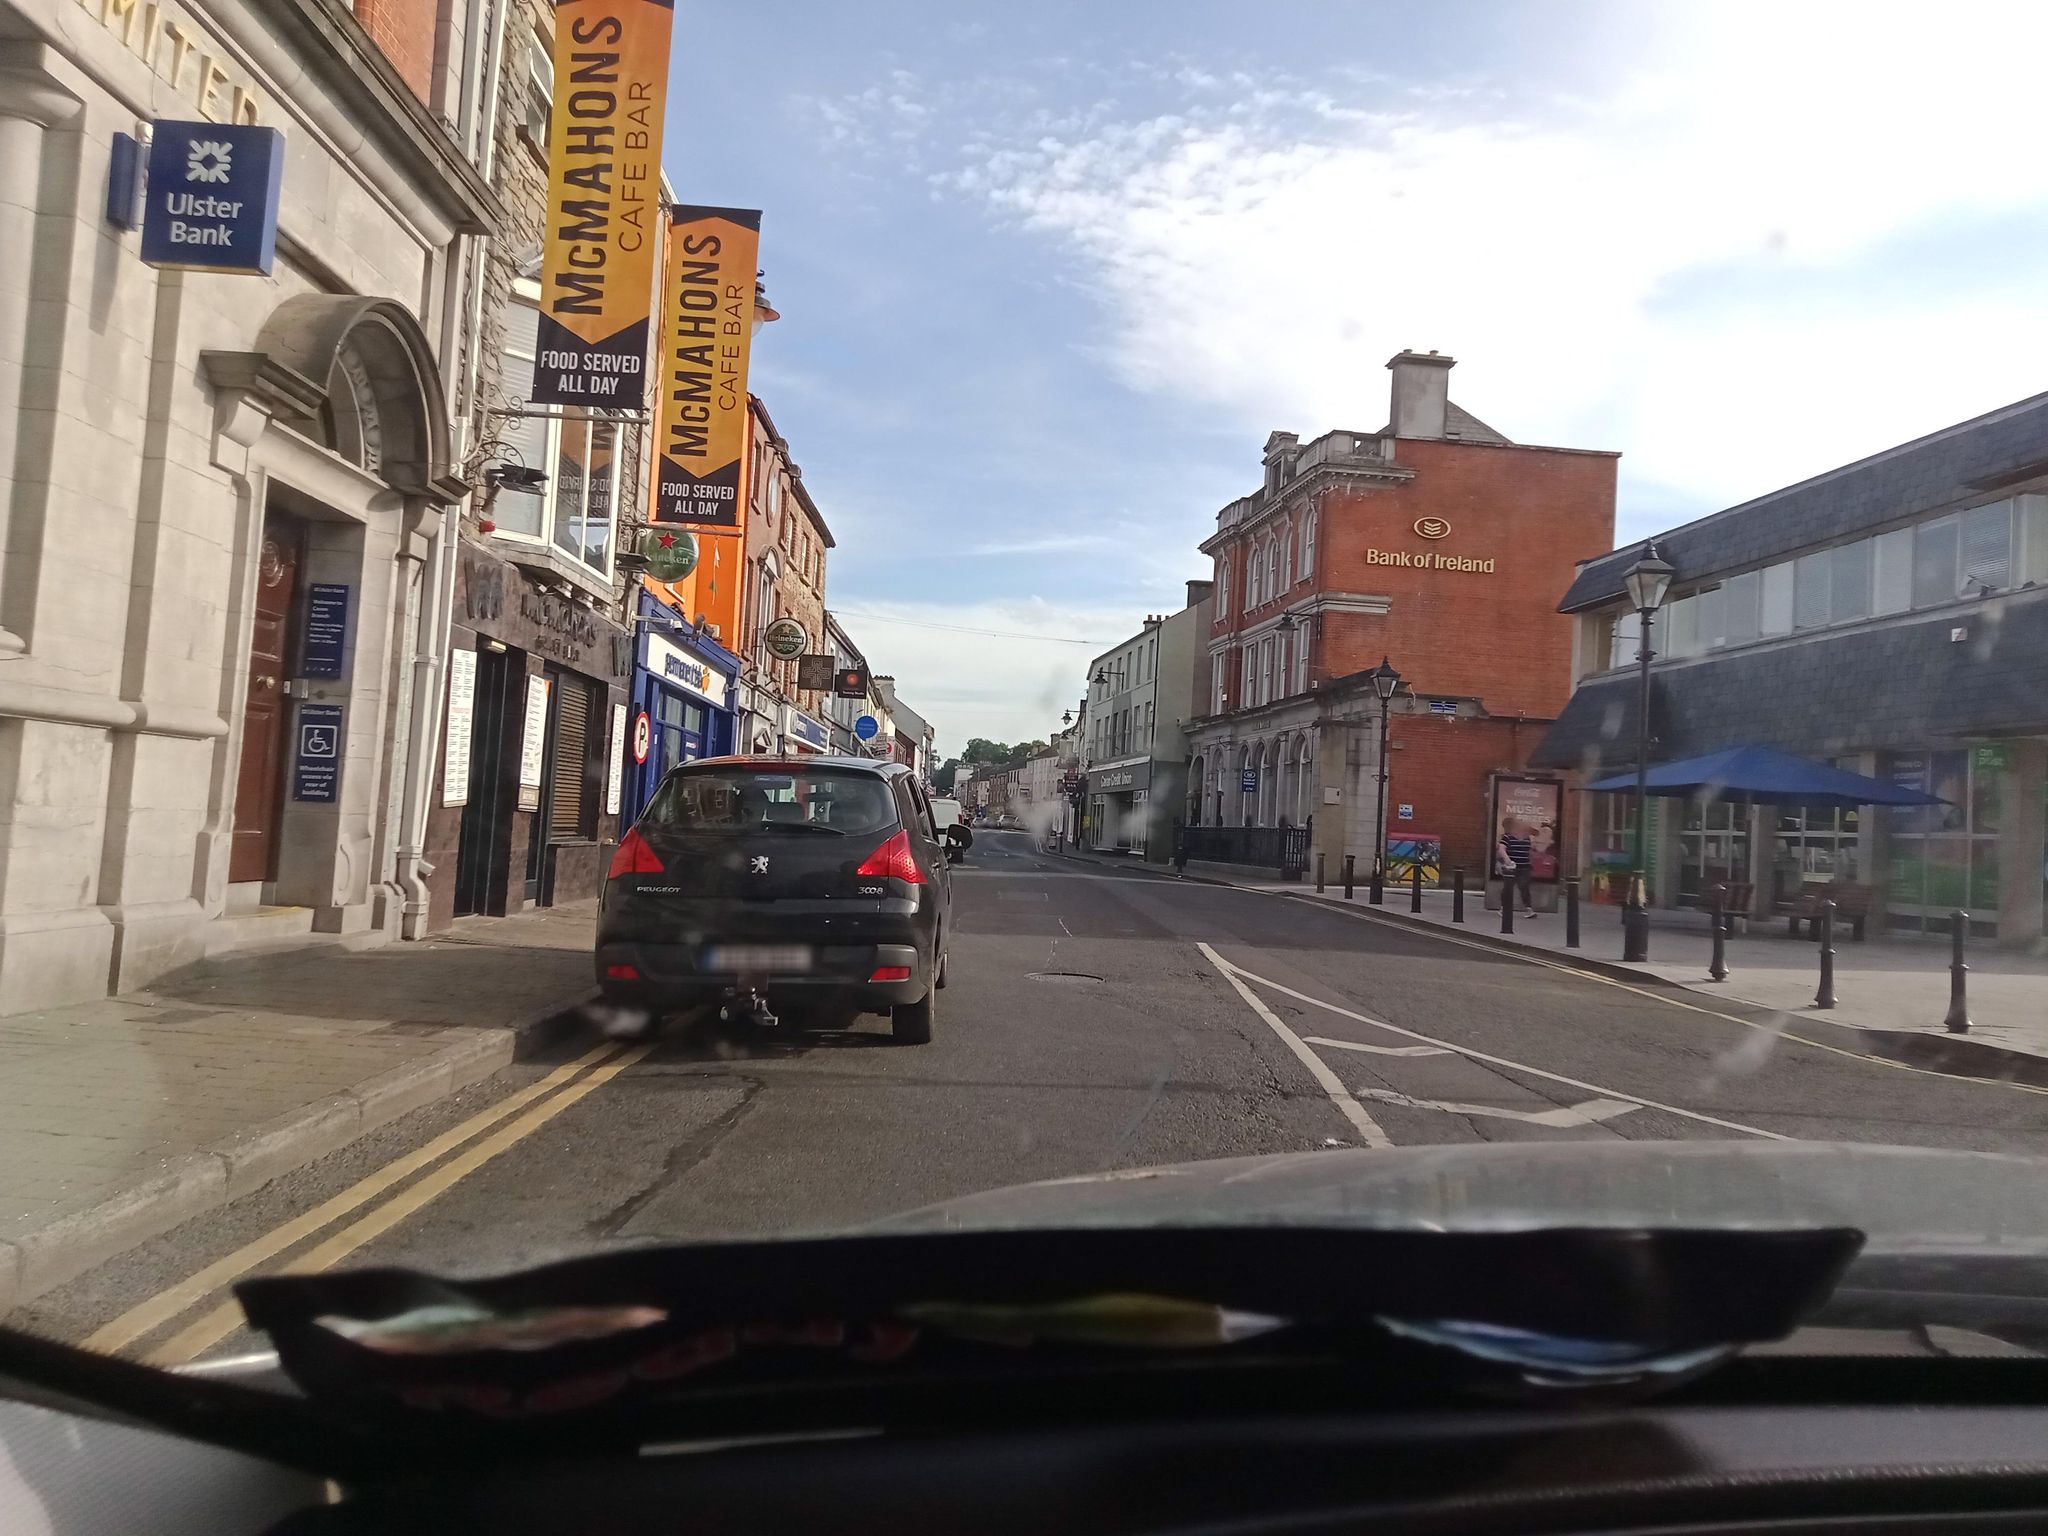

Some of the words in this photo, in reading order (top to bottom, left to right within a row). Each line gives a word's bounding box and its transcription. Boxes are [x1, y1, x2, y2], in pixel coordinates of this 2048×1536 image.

[625, 82, 653, 149] BAR
[553, 16, 623, 315] McMAHONS
[167, 192, 243, 219] Ulster
[619, 163, 647, 252] CAFE
[170, 221, 234, 247] Bank
[723, 284, 744, 336] BAR
[670, 234, 722, 457] McMAHONS
[541, 351, 578, 370] FOOD
[583, 353, 640, 374] SERVED
[558, 374, 585, 393] ALL
[590, 376, 619, 395] DAY
[718, 345, 740, 411] CAFE
[661, 482, 690, 497] FOOD
[693, 484, 734, 500] SERVED
[674, 500, 694, 514] ALL
[698, 501, 719, 516] DAY
[1366, 548, 1411, 567] Bank
[1413, 553, 1433, 568] of
[1434, 554, 1495, 573] Ireland
[1505, 803, 1544, 814] MUSIC
[858, 886, 884, 895] 3008
